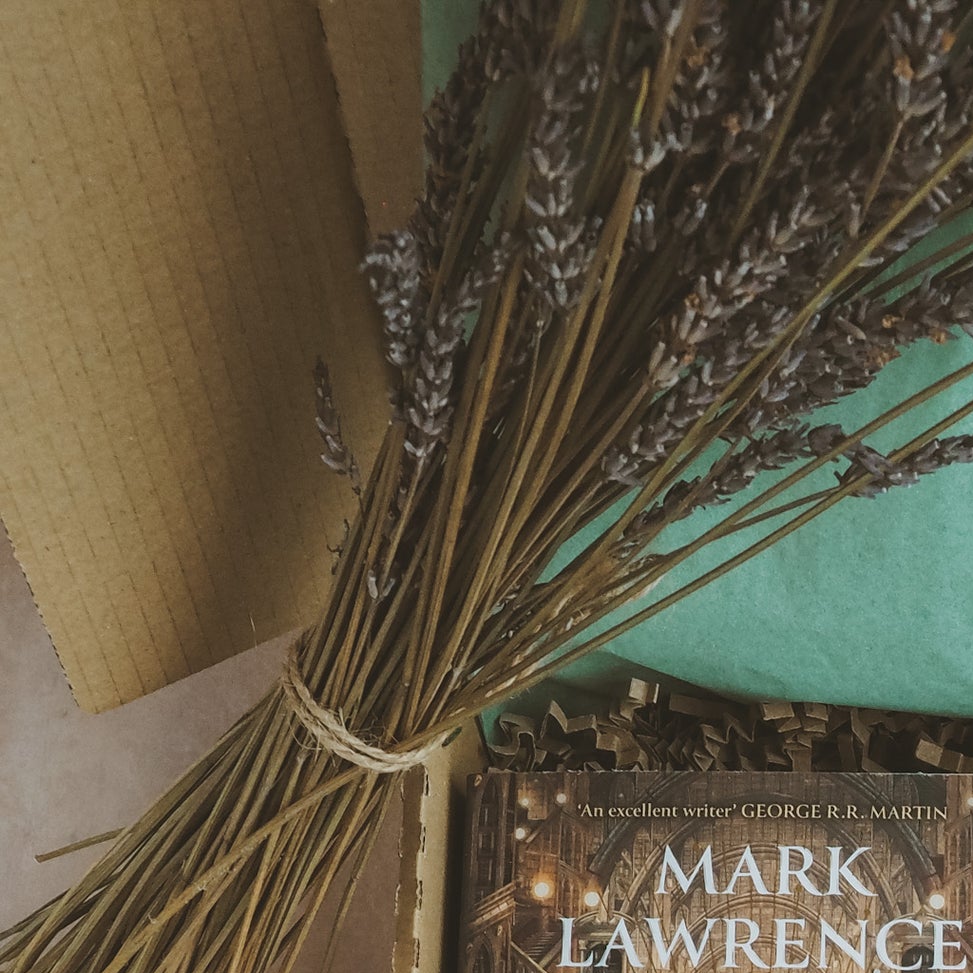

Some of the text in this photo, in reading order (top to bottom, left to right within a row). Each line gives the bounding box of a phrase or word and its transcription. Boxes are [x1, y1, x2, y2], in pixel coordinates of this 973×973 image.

[577, 803, 949, 821] 'An excellent writer' GEORGE R.R. MARTIN
[654, 844, 879, 897] MARK
[557, 916, 968, 972] LAWRENCE
